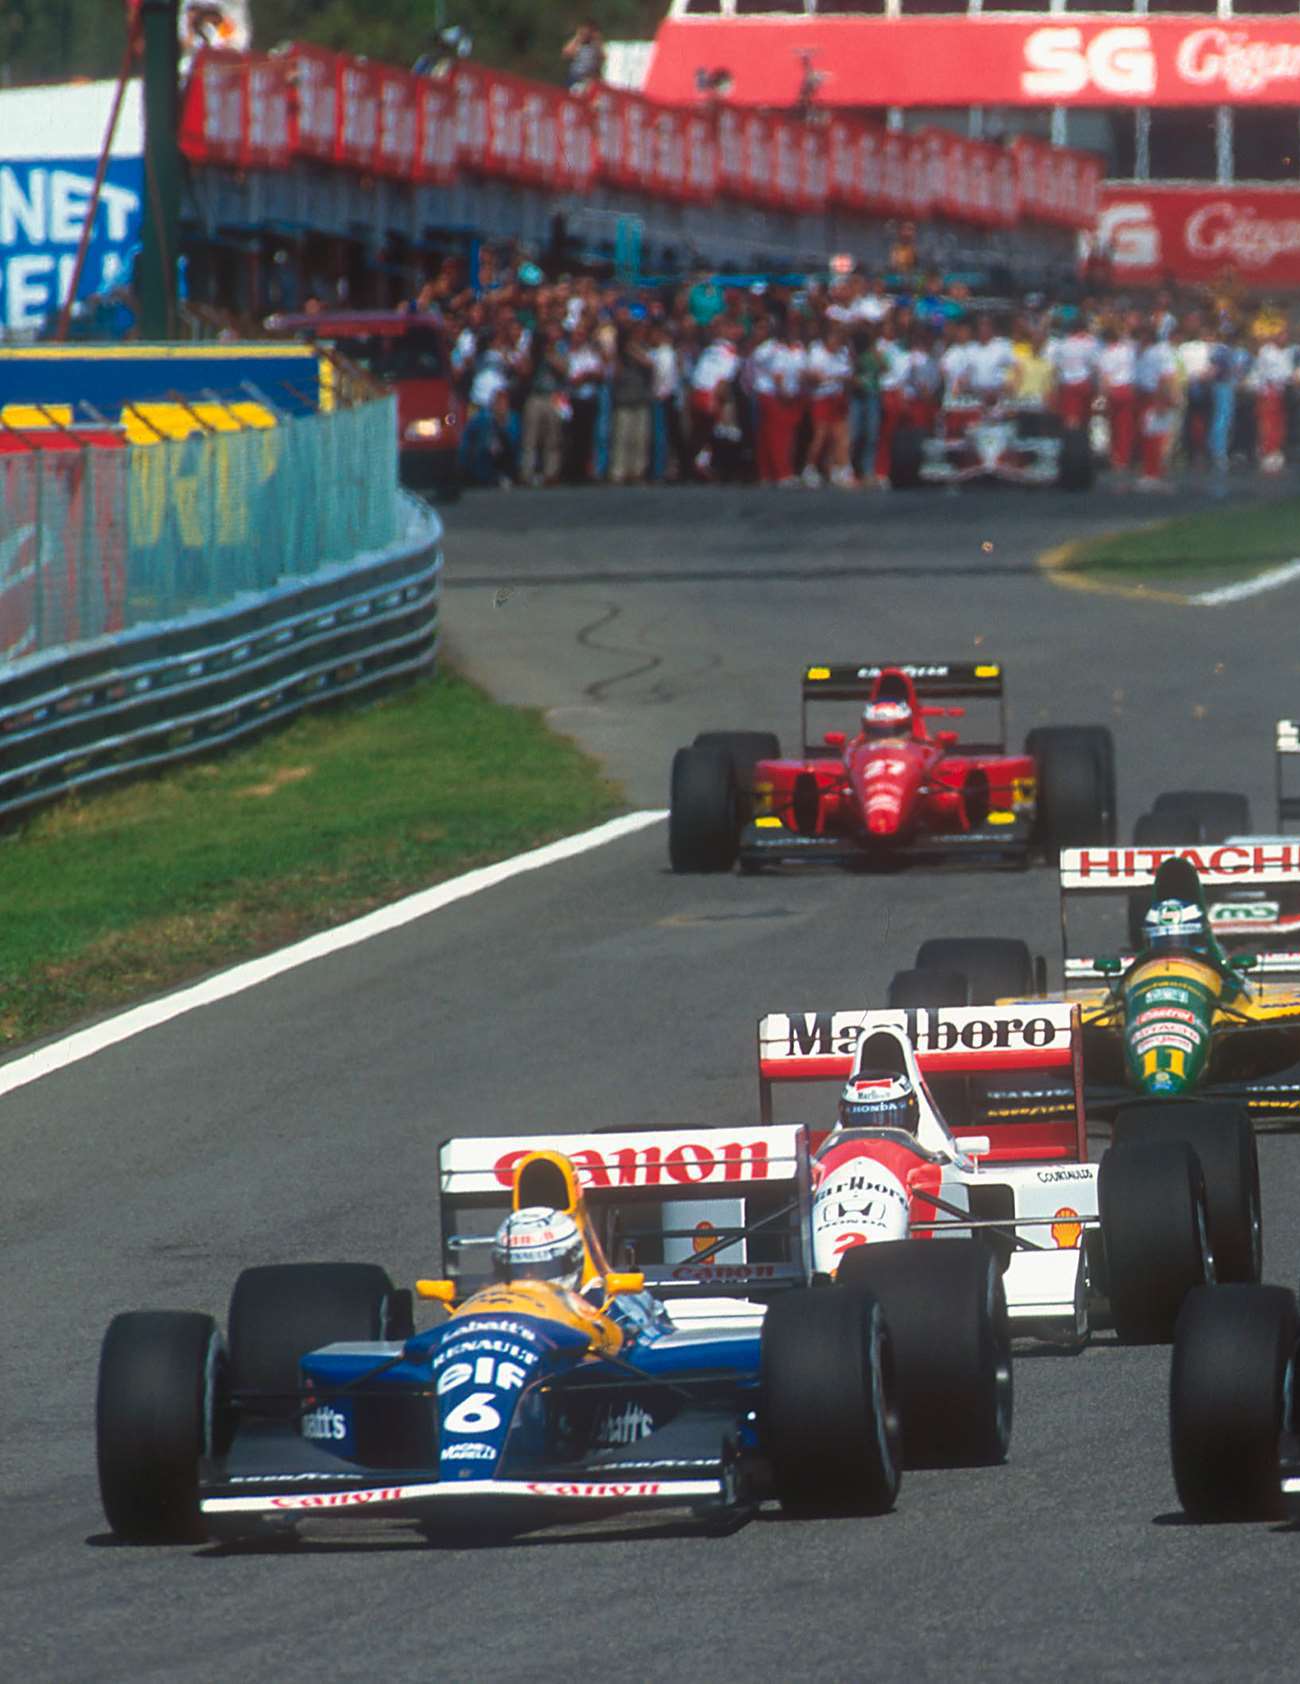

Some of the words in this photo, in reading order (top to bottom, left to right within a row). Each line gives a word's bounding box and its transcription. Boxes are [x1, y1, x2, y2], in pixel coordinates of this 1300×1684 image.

[1021, 27, 1156, 98] SG
[786, 1007, 1056, 1056] Malboro
[1143, 1048, 1186, 1078] 11
[852, 1101, 898, 1113] HONDA
[493, 1141, 768, 1188] Canon
[816, 1176, 909, 1211] arlboro
[833, 1232, 868, 1255] 2
[671, 1265, 774, 1281] Canon
[441, 1320, 536, 1345] Labatt's
[433, 1339, 540, 1370] RENAULT
[437, 1356, 526, 1396] elf
[443, 1392, 501, 1434] 6
